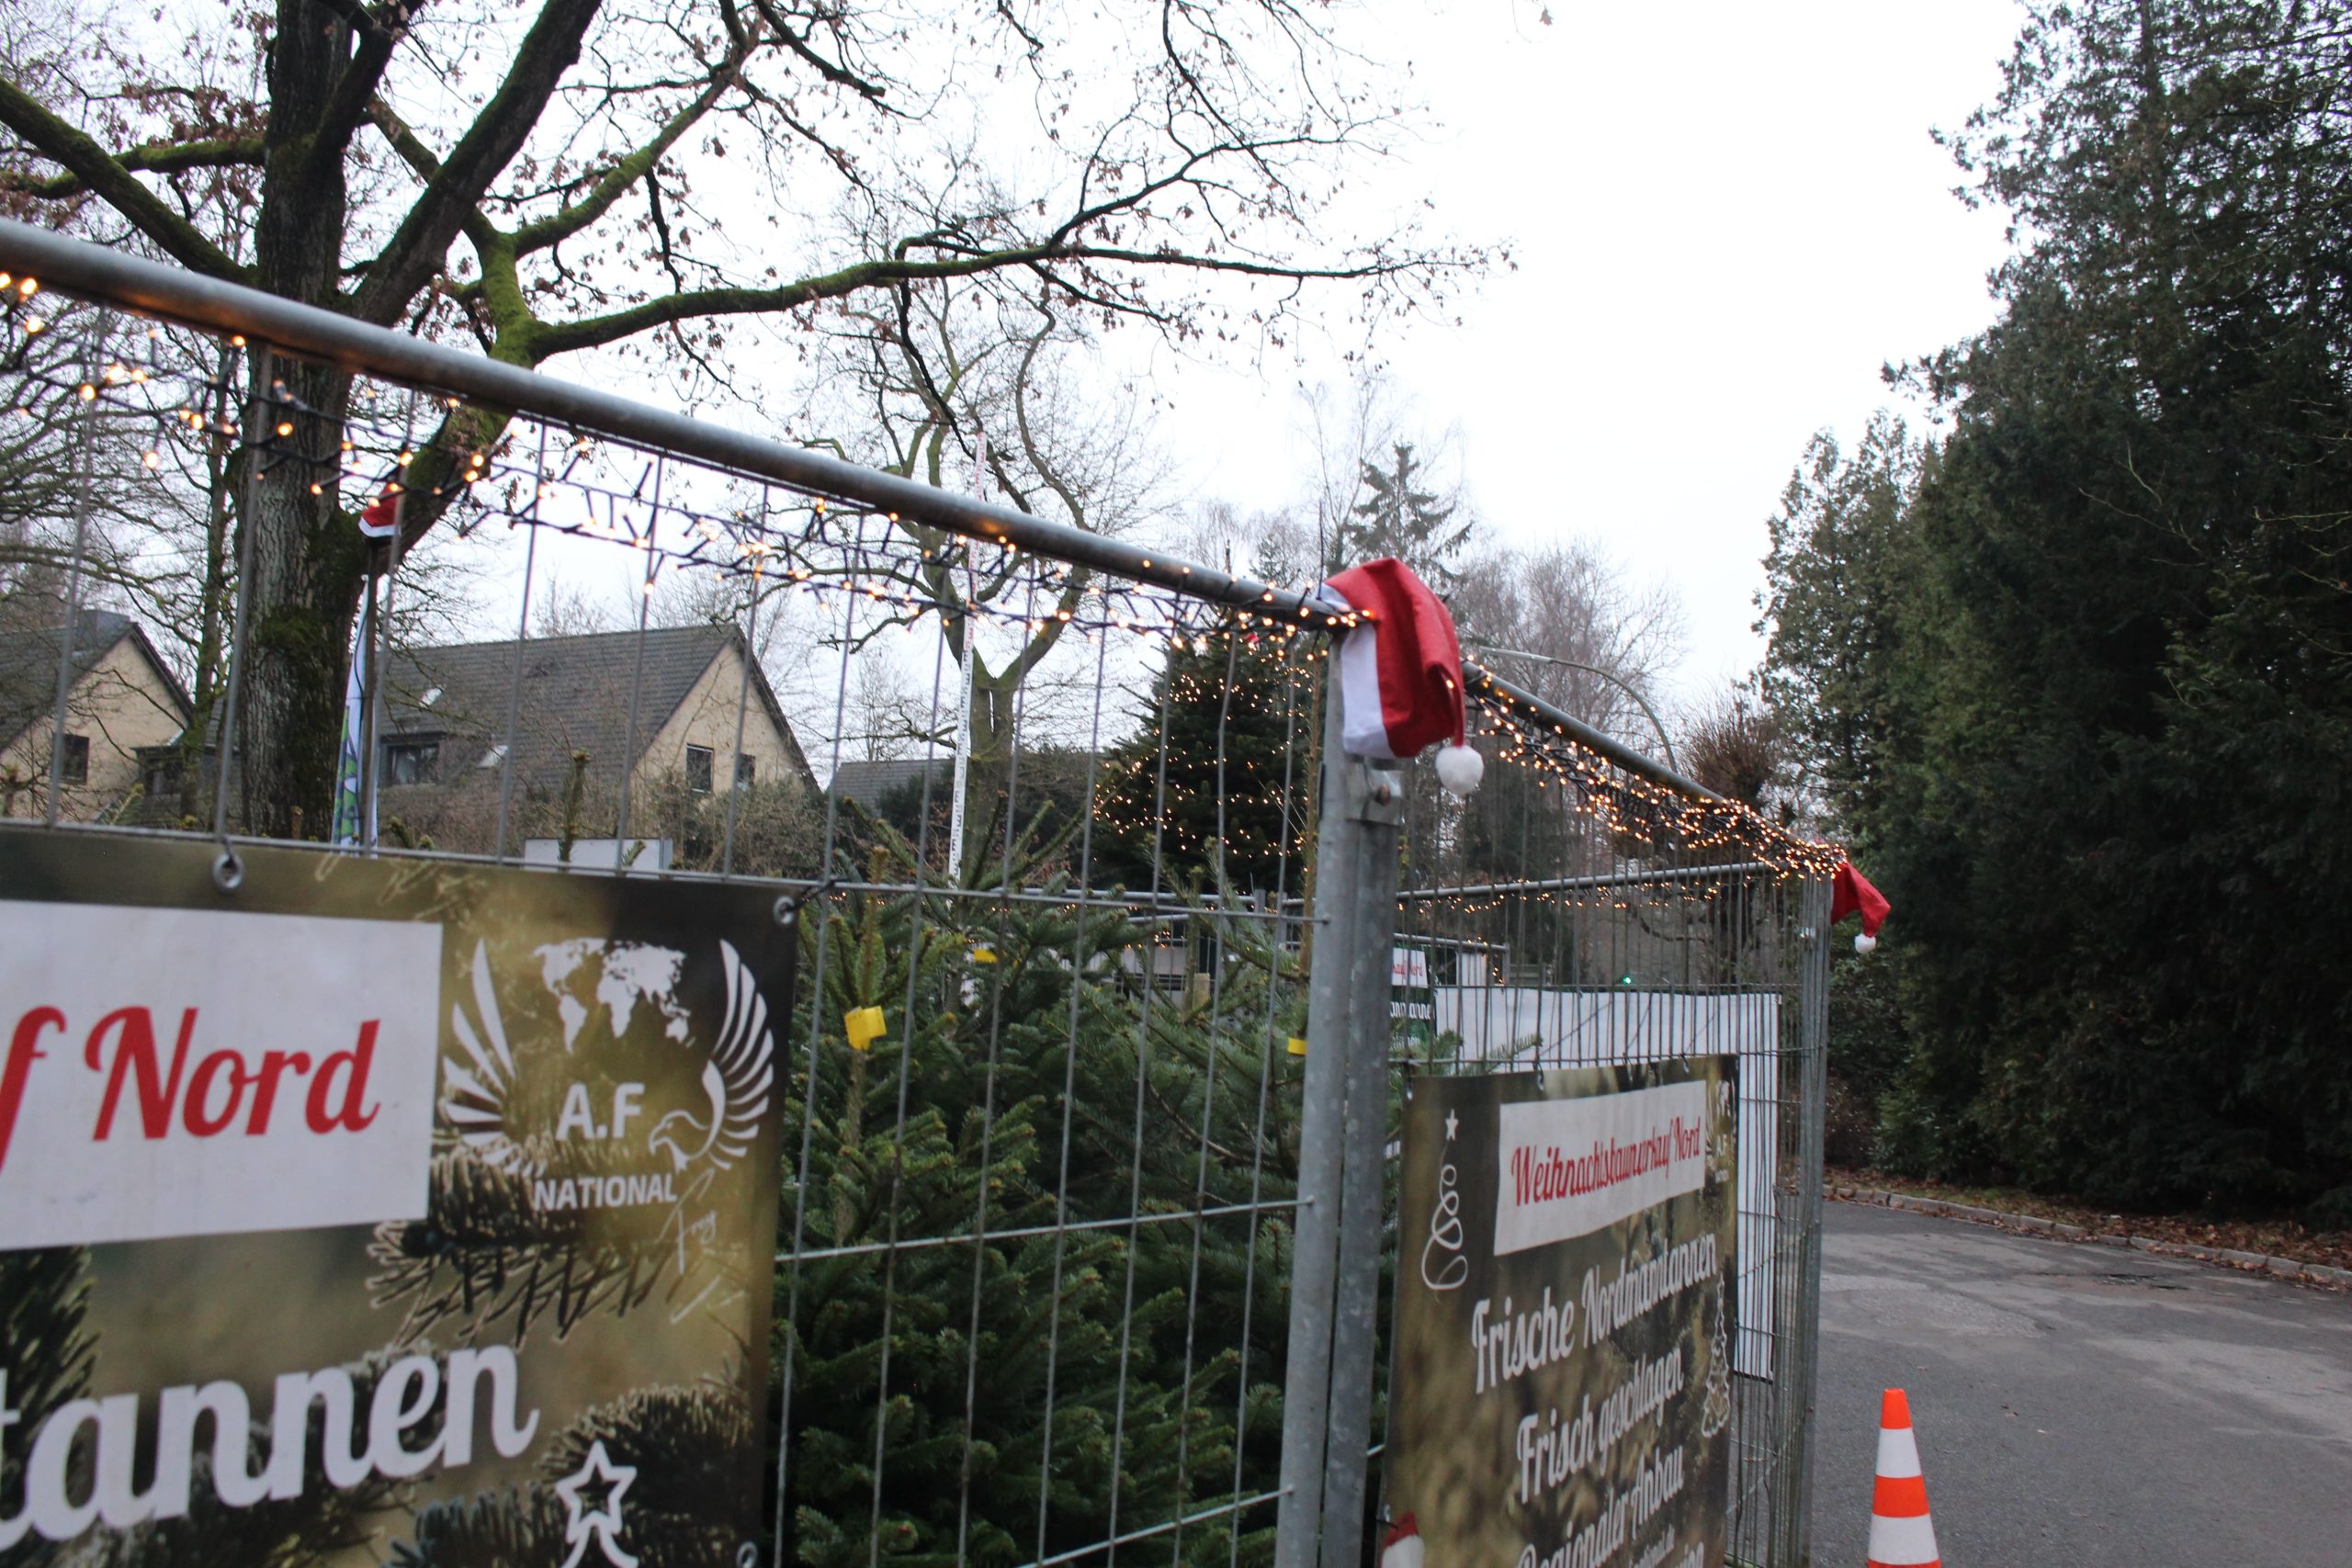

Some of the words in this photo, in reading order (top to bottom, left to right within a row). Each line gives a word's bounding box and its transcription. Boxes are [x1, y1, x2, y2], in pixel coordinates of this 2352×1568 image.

[85, 1004, 380, 1143] Nord
[555, 1082, 645, 1141] A.F
[534, 1173, 677, 1212] NATIONAL
[1674, 1115, 1701, 1162] Nord
[1472, 1286, 1576, 1395] Frische
[1581, 1233, 1717, 1349] Nordmanntannen
[1517, 1393, 1597, 1505] Frisch
[1599, 1347, 1685, 1476] geschlagen
[1517, 1486, 1630, 1568] ionaler
[1630, 1444, 1685, 1540] Anbau
